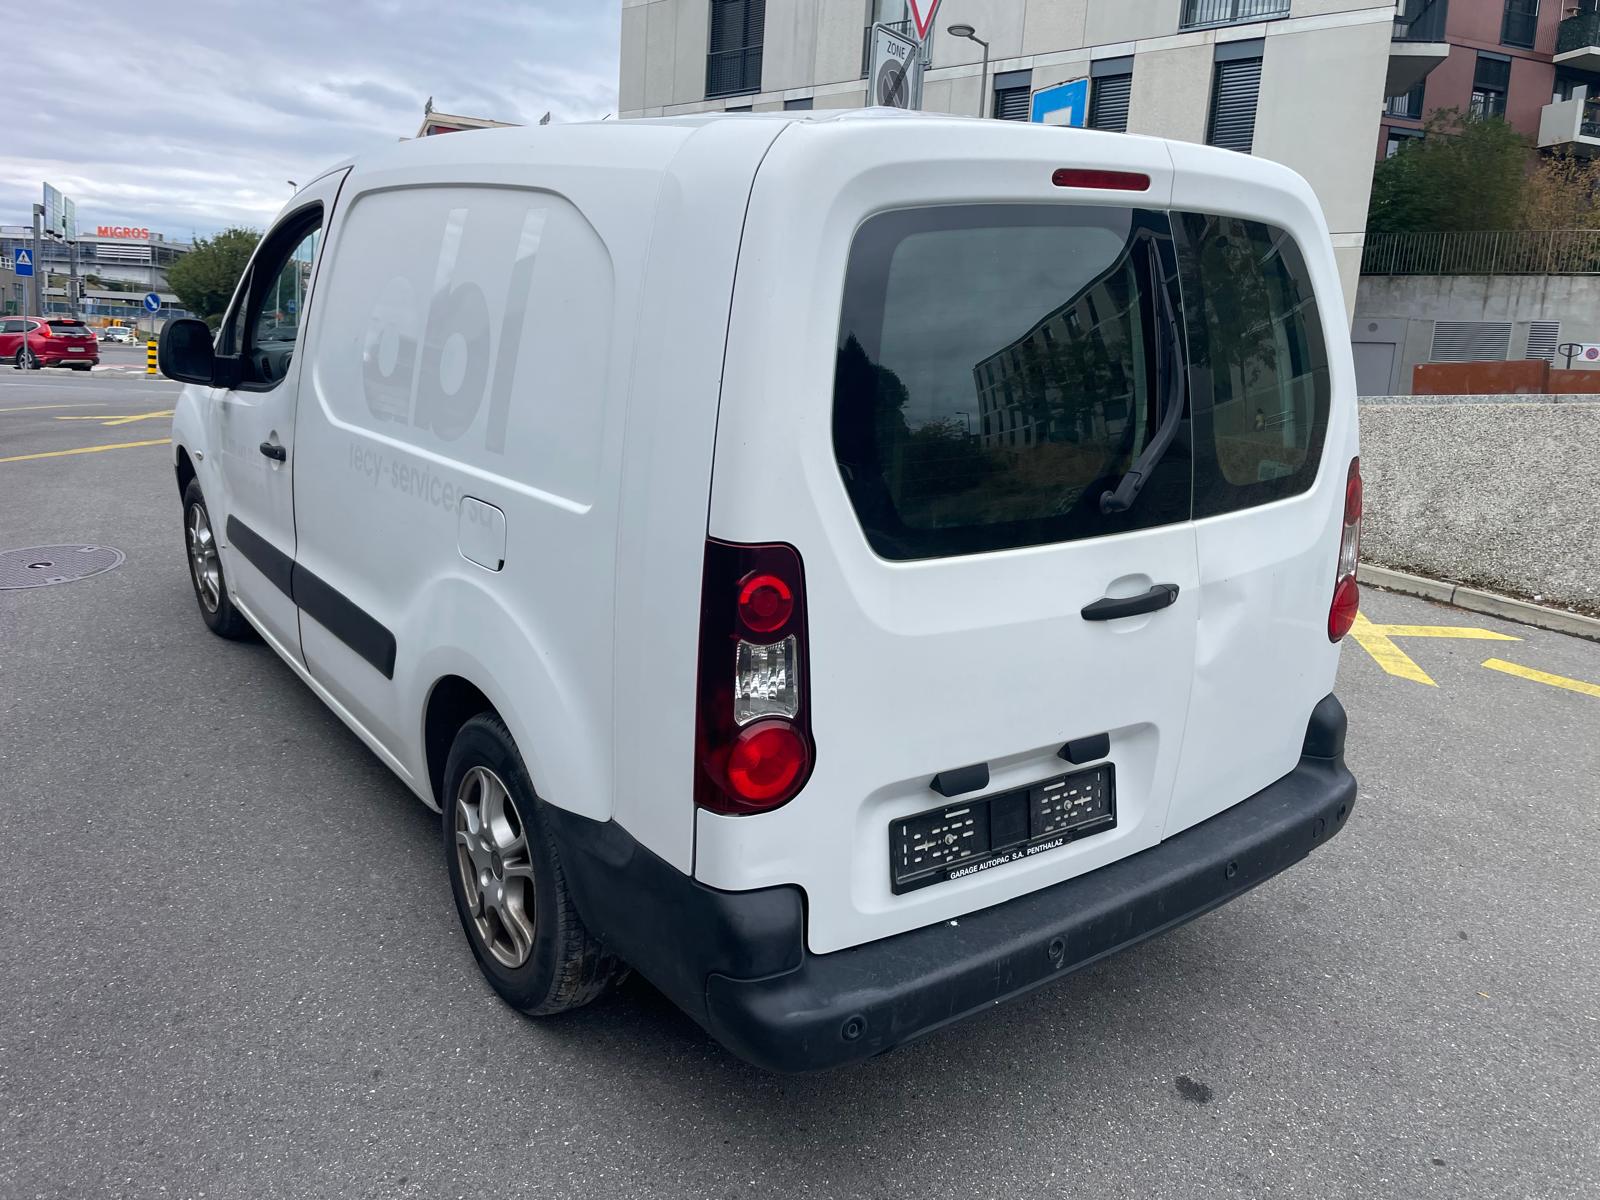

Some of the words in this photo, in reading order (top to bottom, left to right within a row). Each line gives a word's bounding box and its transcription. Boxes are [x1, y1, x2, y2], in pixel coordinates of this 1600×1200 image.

[887, 40, 906, 60] ZONE
[97, 226, 149, 240] MIGROS
[362, 208, 548, 456] abl
[350, 442, 464, 514] recy-services
[950, 865, 978, 880] GARAGE
[979, 855, 1010, 871] AUTOPAC
[1012, 851, 1024, 860] S.A.
[1026, 838, 1063, 856] PENTHALAZ
